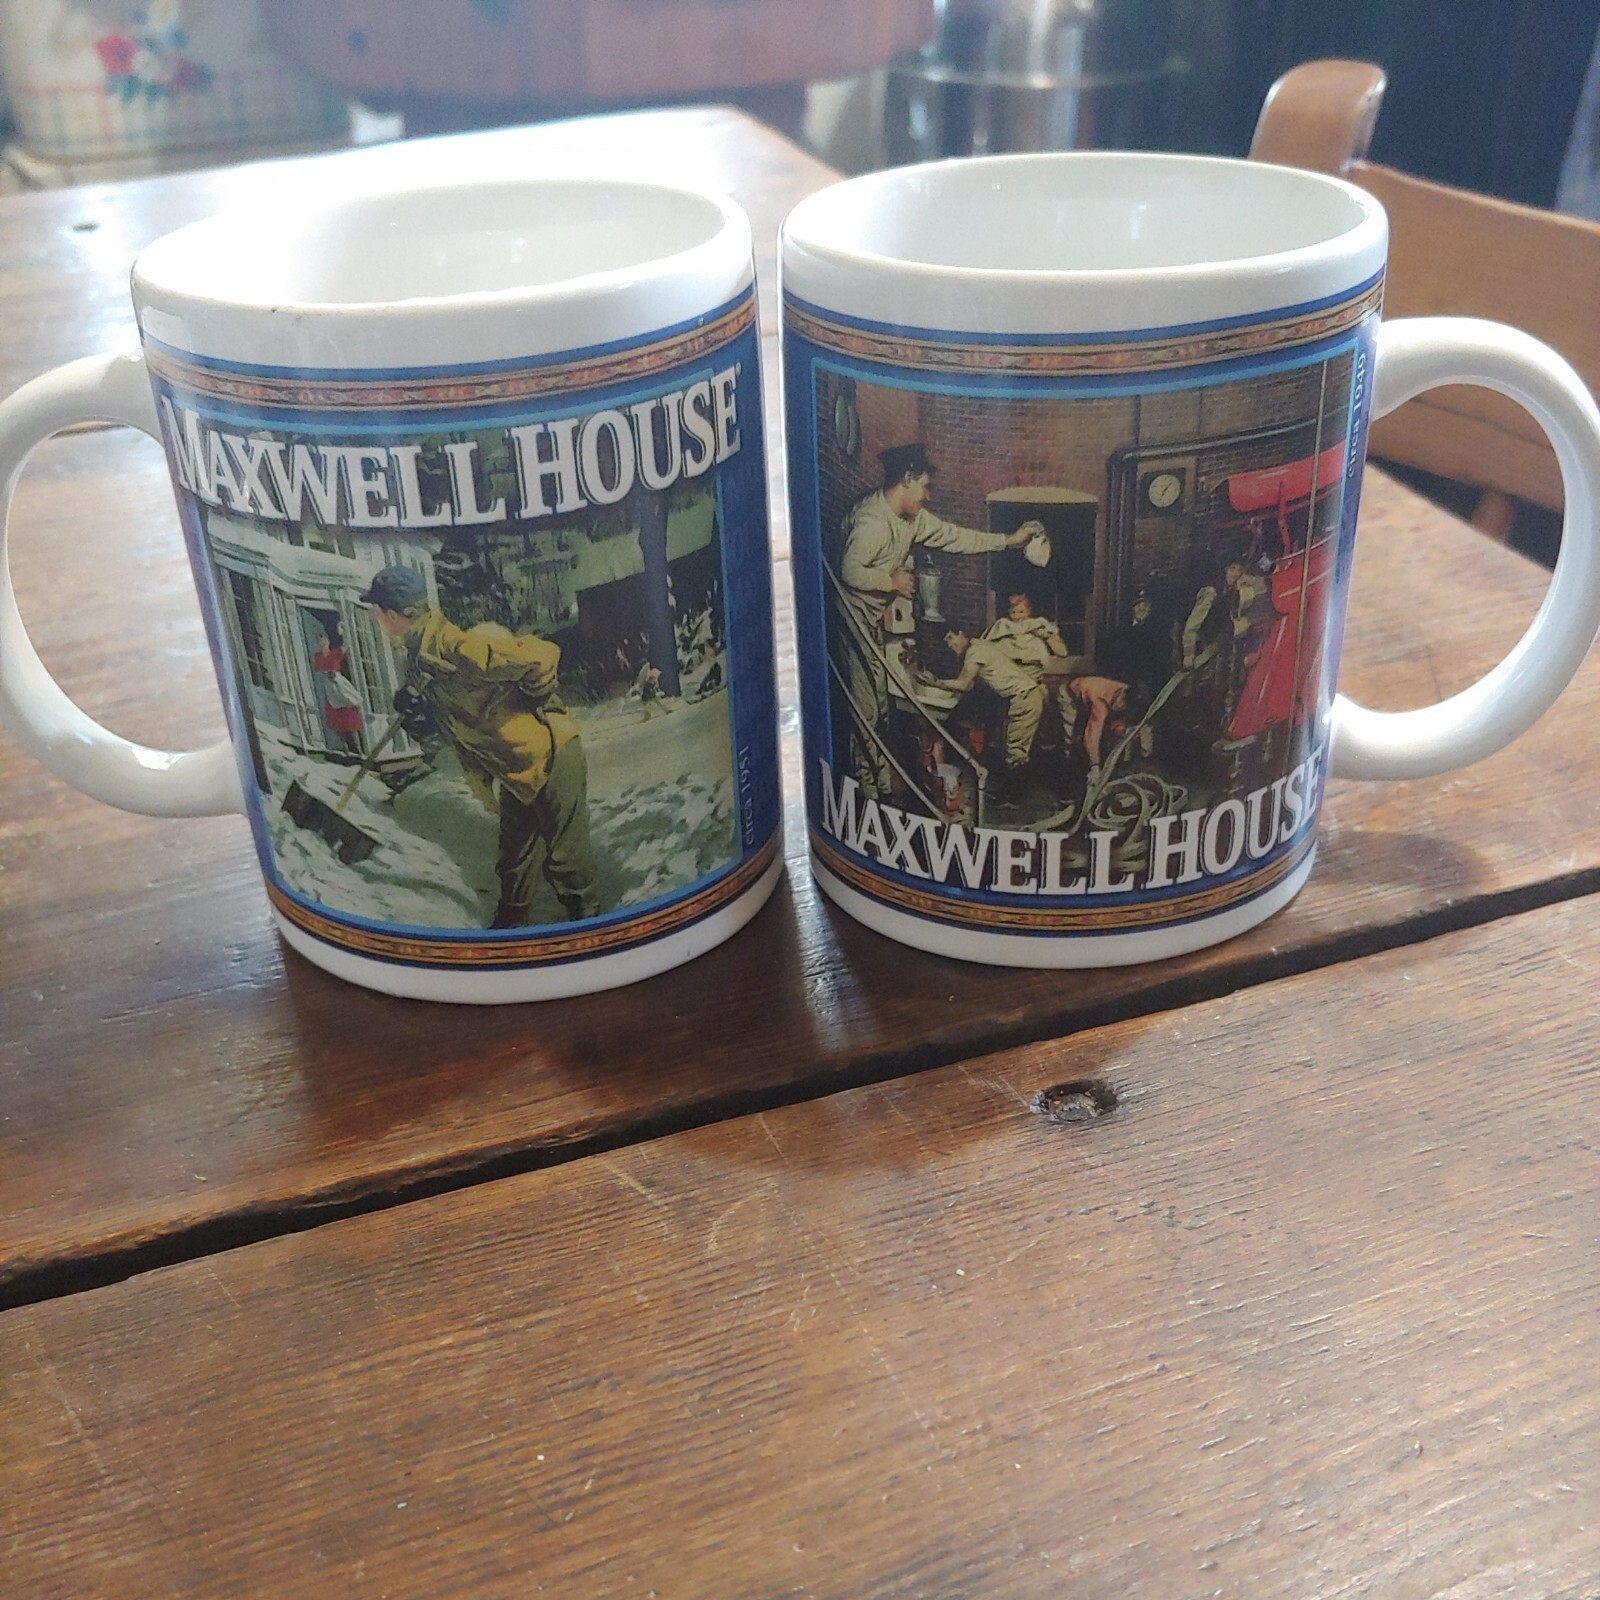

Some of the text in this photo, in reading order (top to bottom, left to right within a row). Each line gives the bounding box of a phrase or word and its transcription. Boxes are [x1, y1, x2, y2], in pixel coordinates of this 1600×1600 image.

[161, 366, 741, 528] MAXWELL HOUSE
[1346, 352, 1367, 479] circa 1949
[739, 745, 755, 845] circa 1951
[820, 746, 1323, 895] MAXWELL HOUSE
